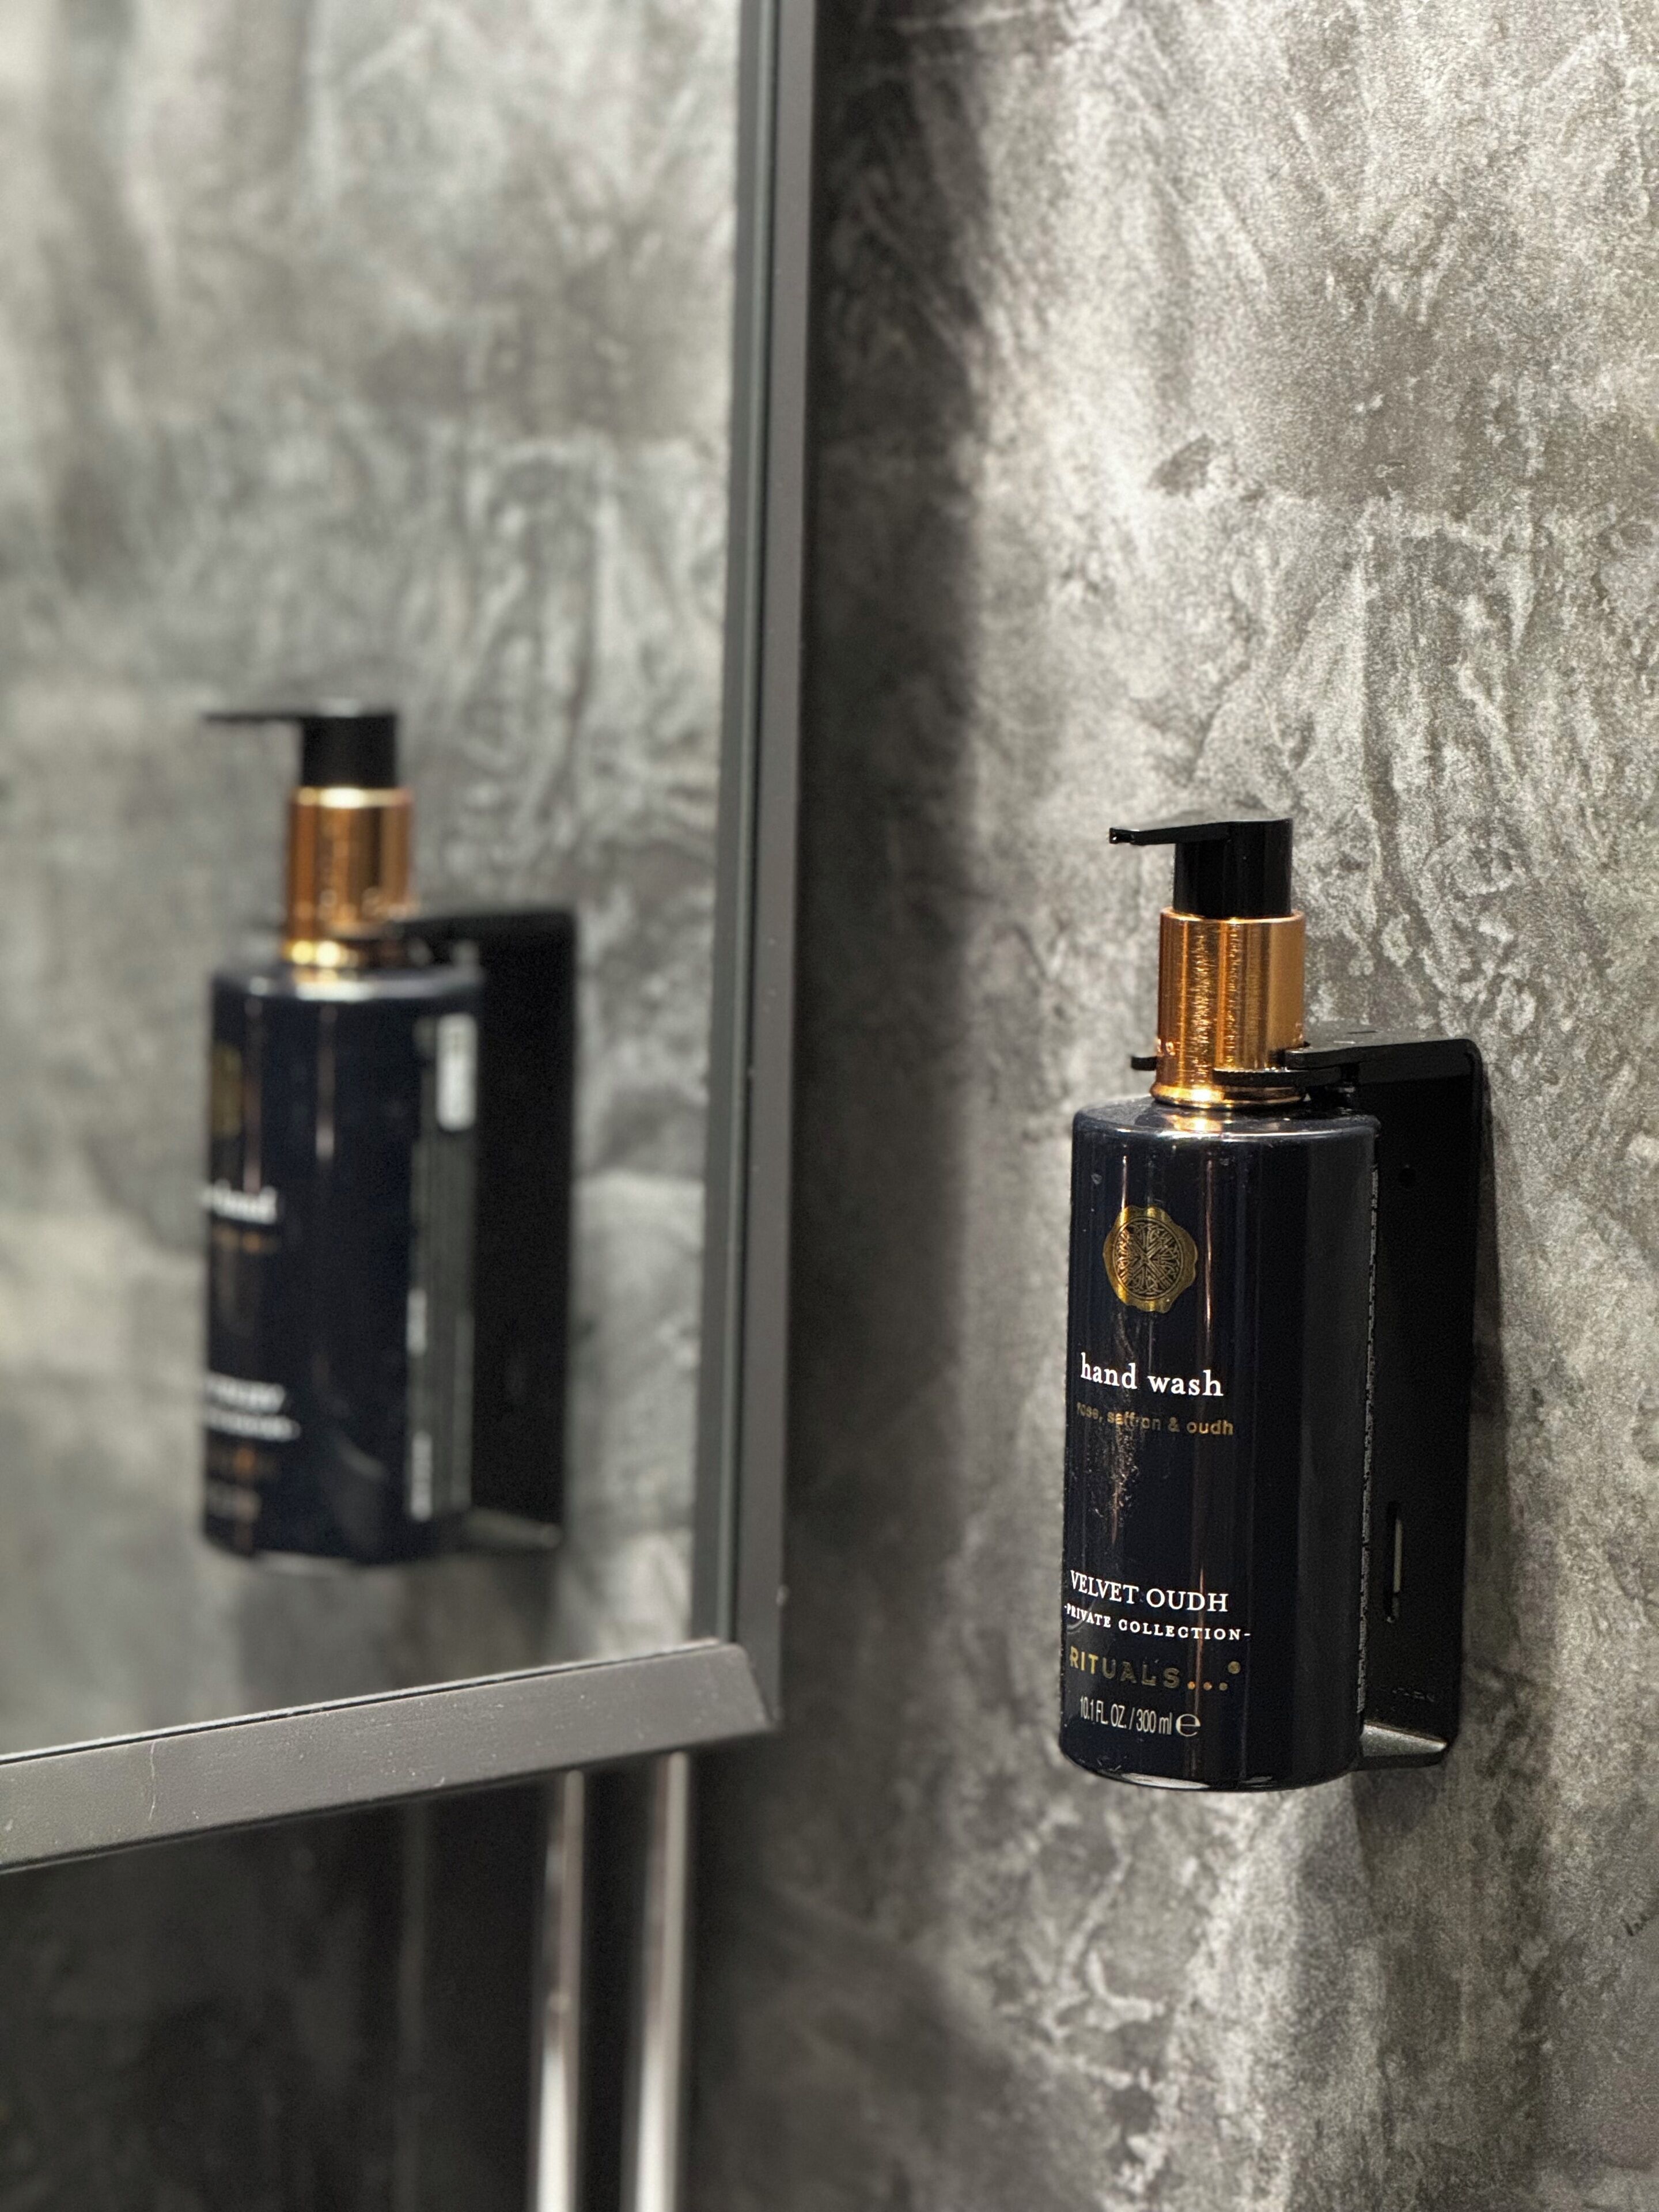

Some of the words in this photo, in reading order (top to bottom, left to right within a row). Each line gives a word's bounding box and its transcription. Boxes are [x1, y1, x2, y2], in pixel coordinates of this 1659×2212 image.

[1081, 1352, 1138, 1389] hand
[1147, 1369, 1224, 1396] wash
[1168, 1416, 1180, 1433] &
[1187, 1419, 1234, 1435] oudh
[1070, 1570, 1139, 1604] VELVET
[1146, 1588, 1229, 1612] OUDH
[1080, 1696, 1094, 1722] 10.1
[1136, 1709, 1156, 1733] 300
[1158, 1712, 1172, 1735] ml
